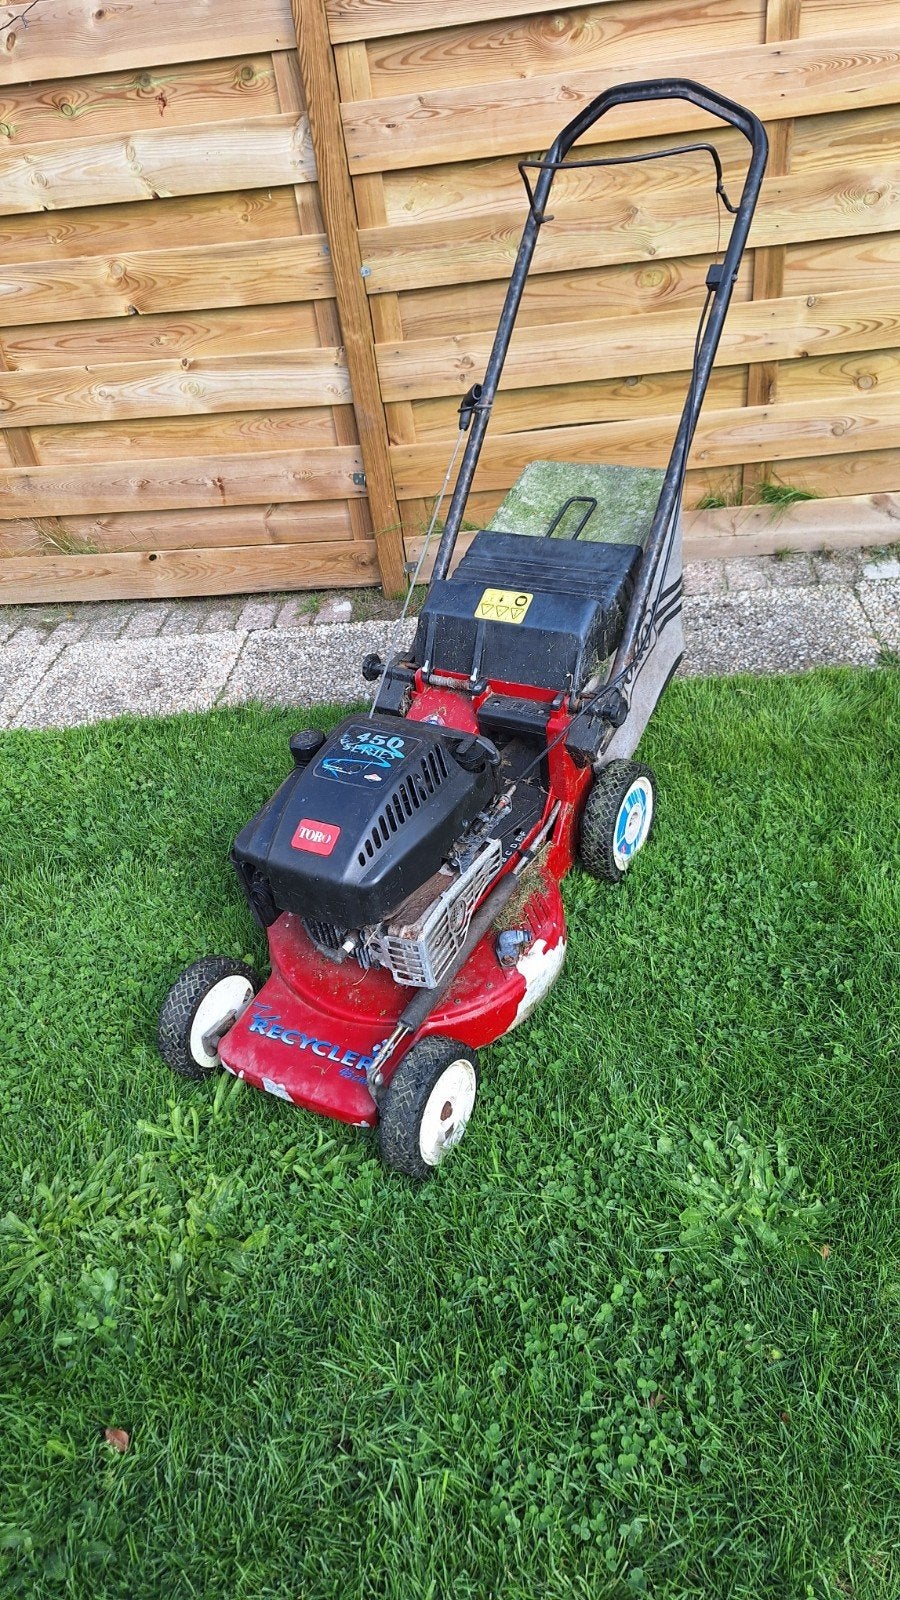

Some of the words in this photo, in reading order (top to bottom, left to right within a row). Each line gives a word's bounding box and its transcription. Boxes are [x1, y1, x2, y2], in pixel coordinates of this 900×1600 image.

[357, 733, 404, 749] 450
[342, 743, 395, 760] SERIES
[299, 826, 332, 844] TORO
[249, 1016, 375, 1070] RECYCLER
